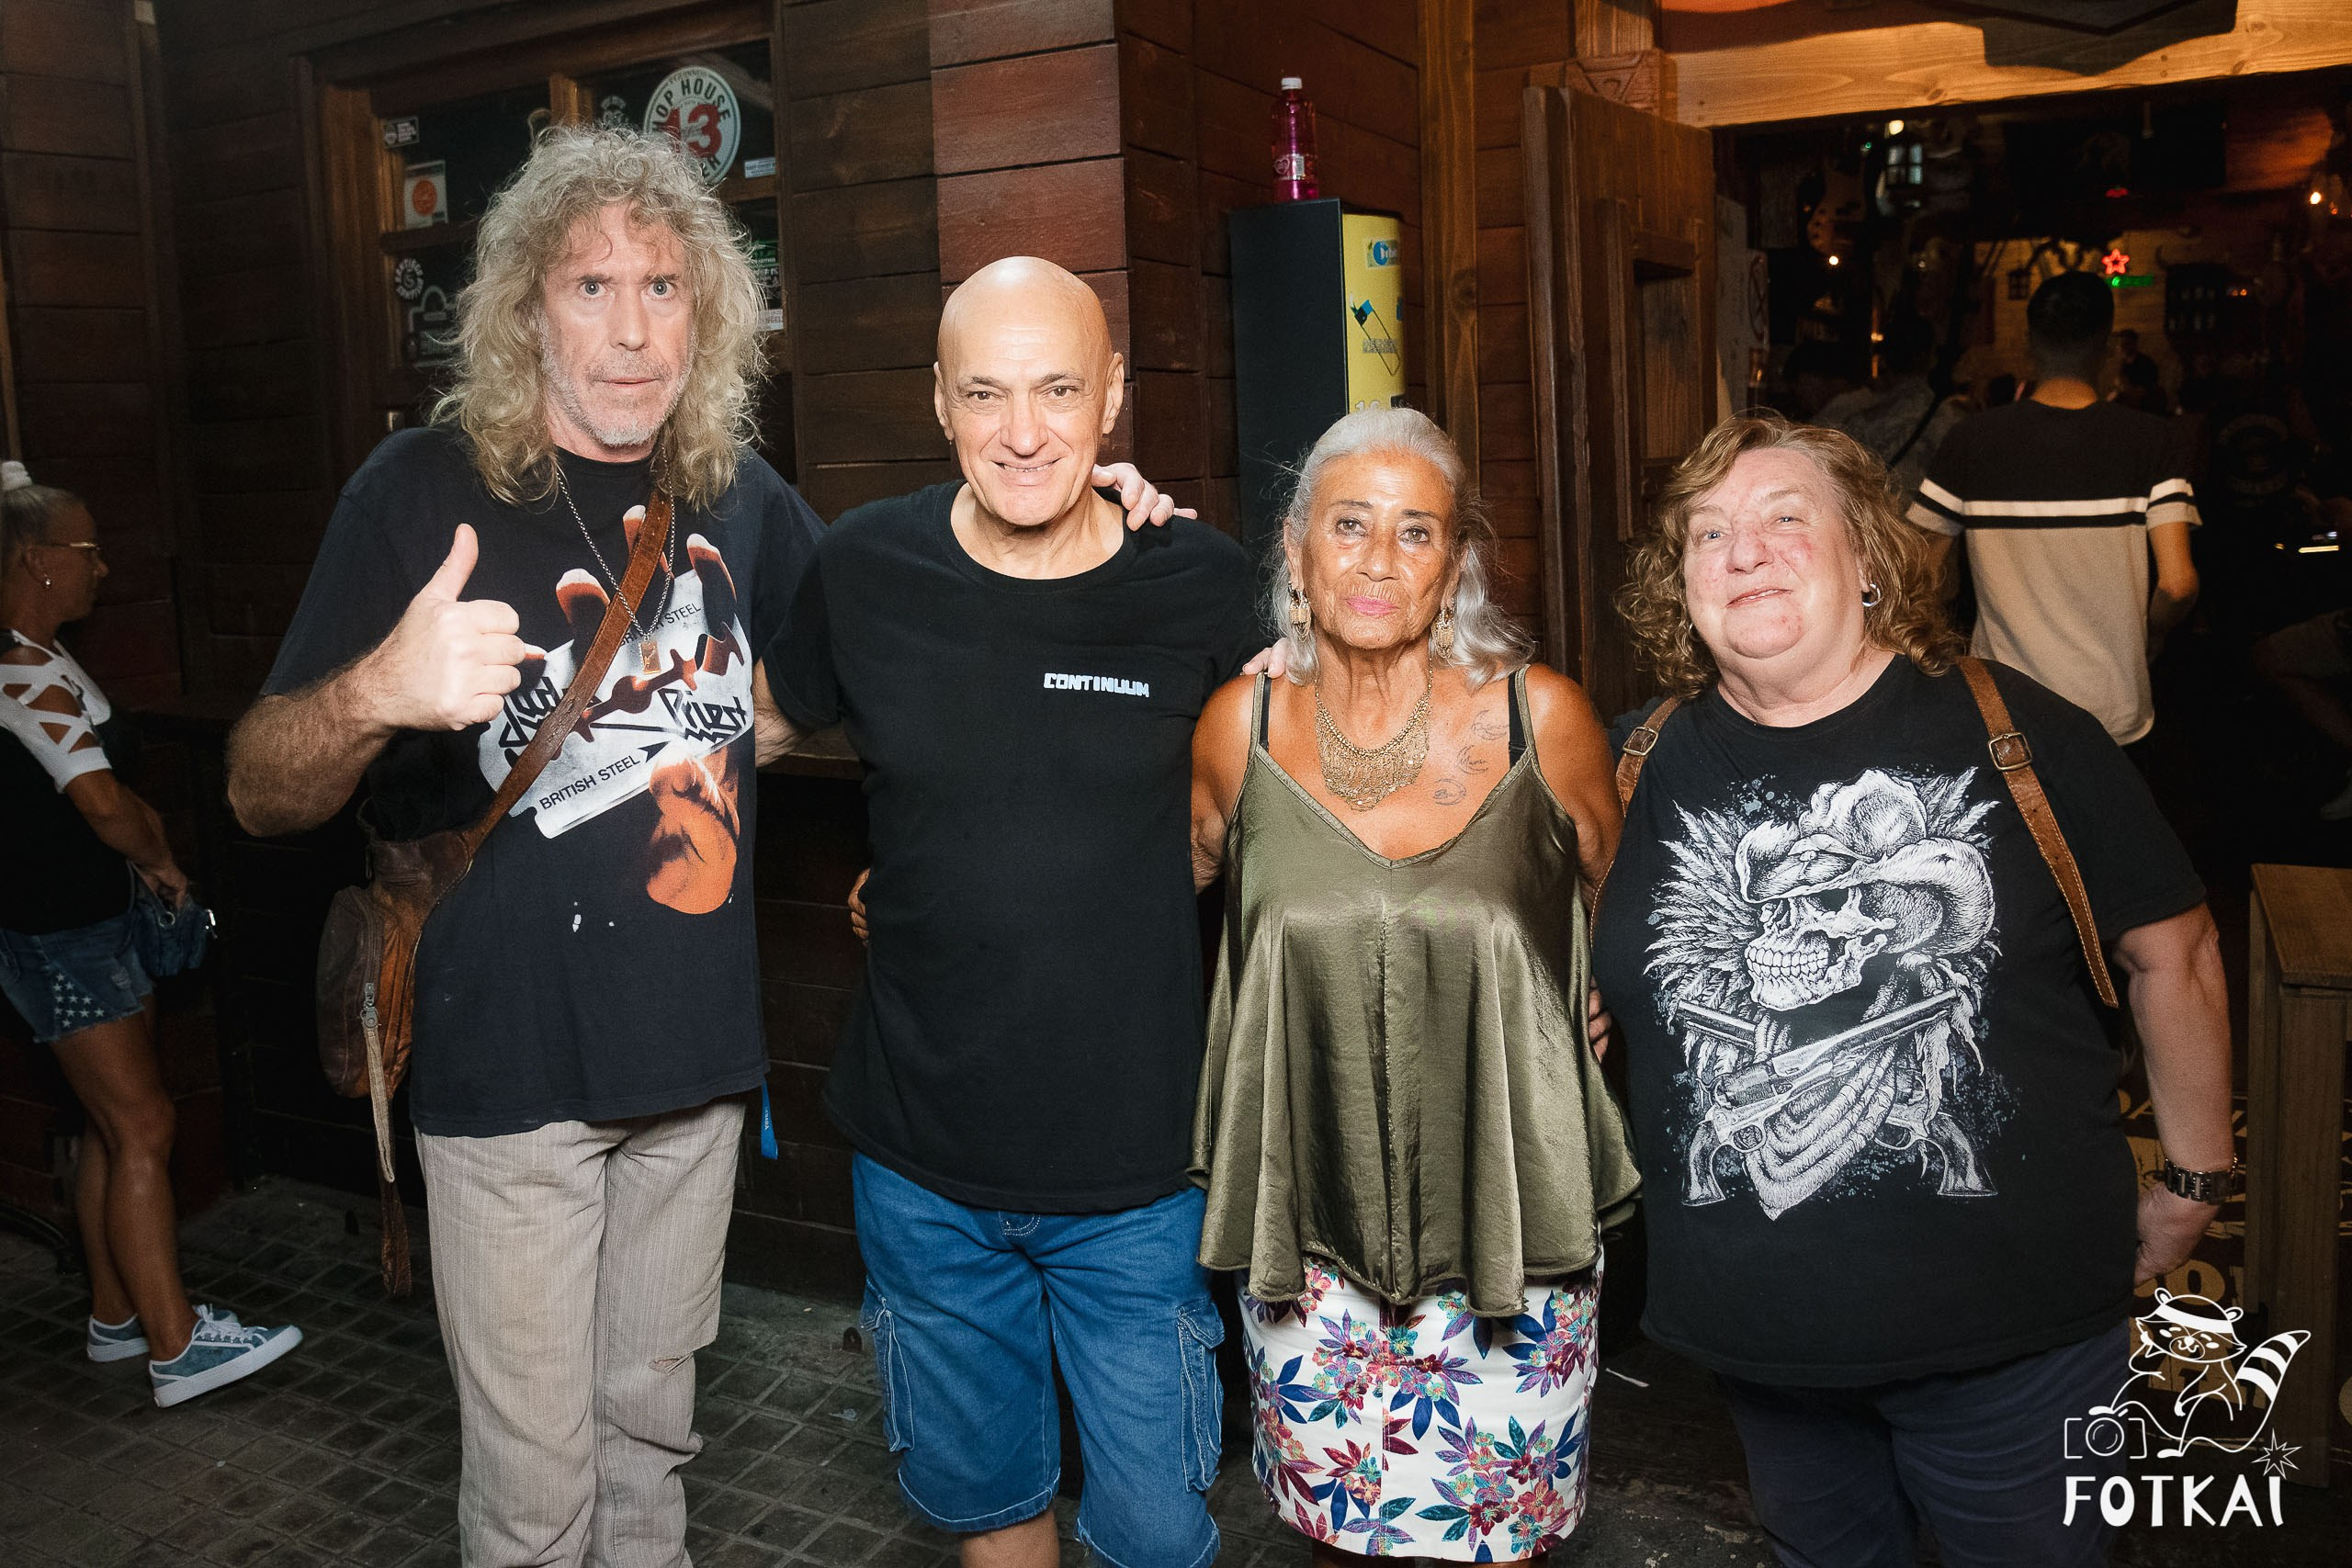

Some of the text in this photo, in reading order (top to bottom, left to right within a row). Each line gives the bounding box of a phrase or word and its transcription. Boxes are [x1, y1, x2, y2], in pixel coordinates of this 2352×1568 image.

[681, 78, 731, 122] HOUSE
[663, 102, 723, 159] 13
[665, 603, 702, 625] STEEL
[1044, 672, 1149, 698] CONTINUUM
[538, 755, 640, 810] BRITISH STEEL
